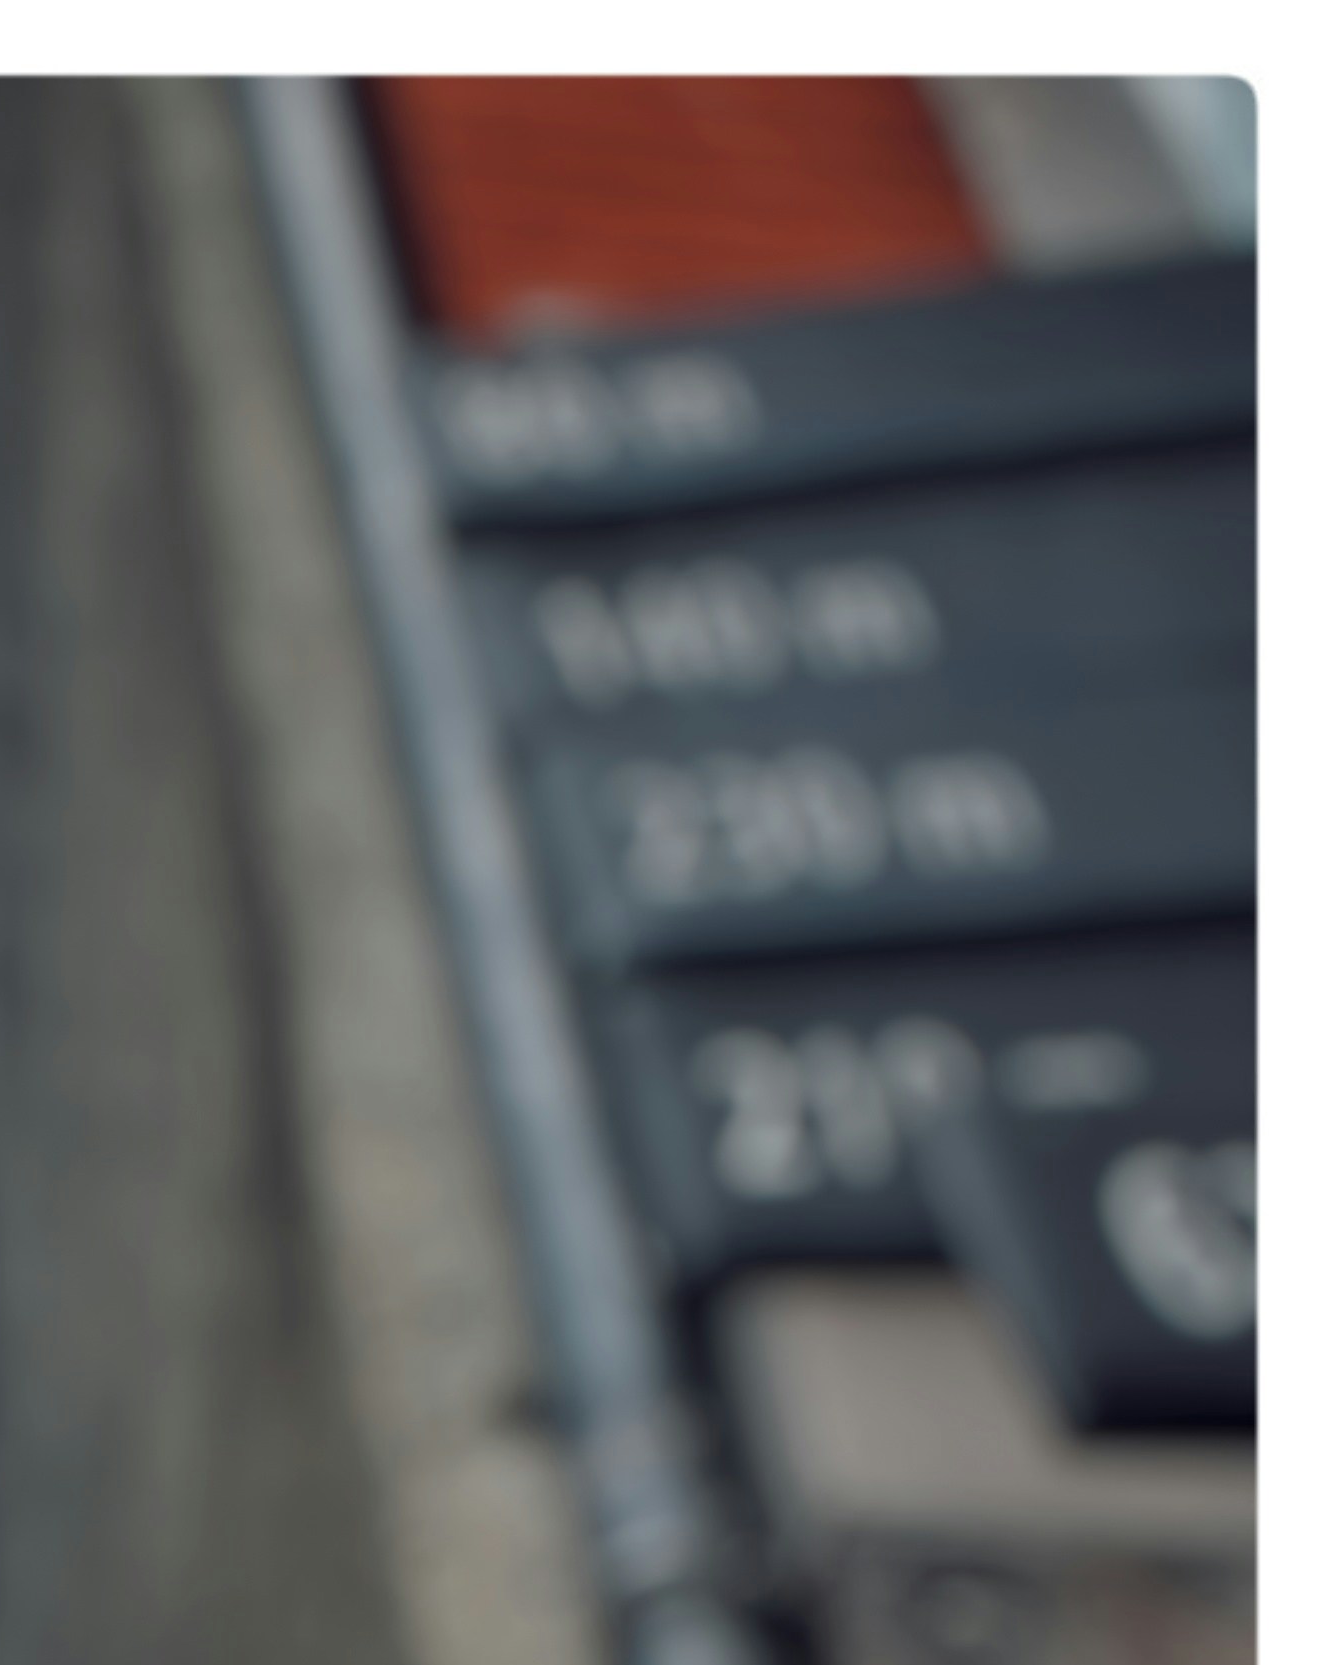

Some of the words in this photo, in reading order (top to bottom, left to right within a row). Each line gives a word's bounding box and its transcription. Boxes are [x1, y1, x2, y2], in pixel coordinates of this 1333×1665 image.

[545, 566, 775, 698] 140
[803, 568, 933, 672] m
[613, 754, 875, 893] 230
[901, 760, 1041, 867] m
